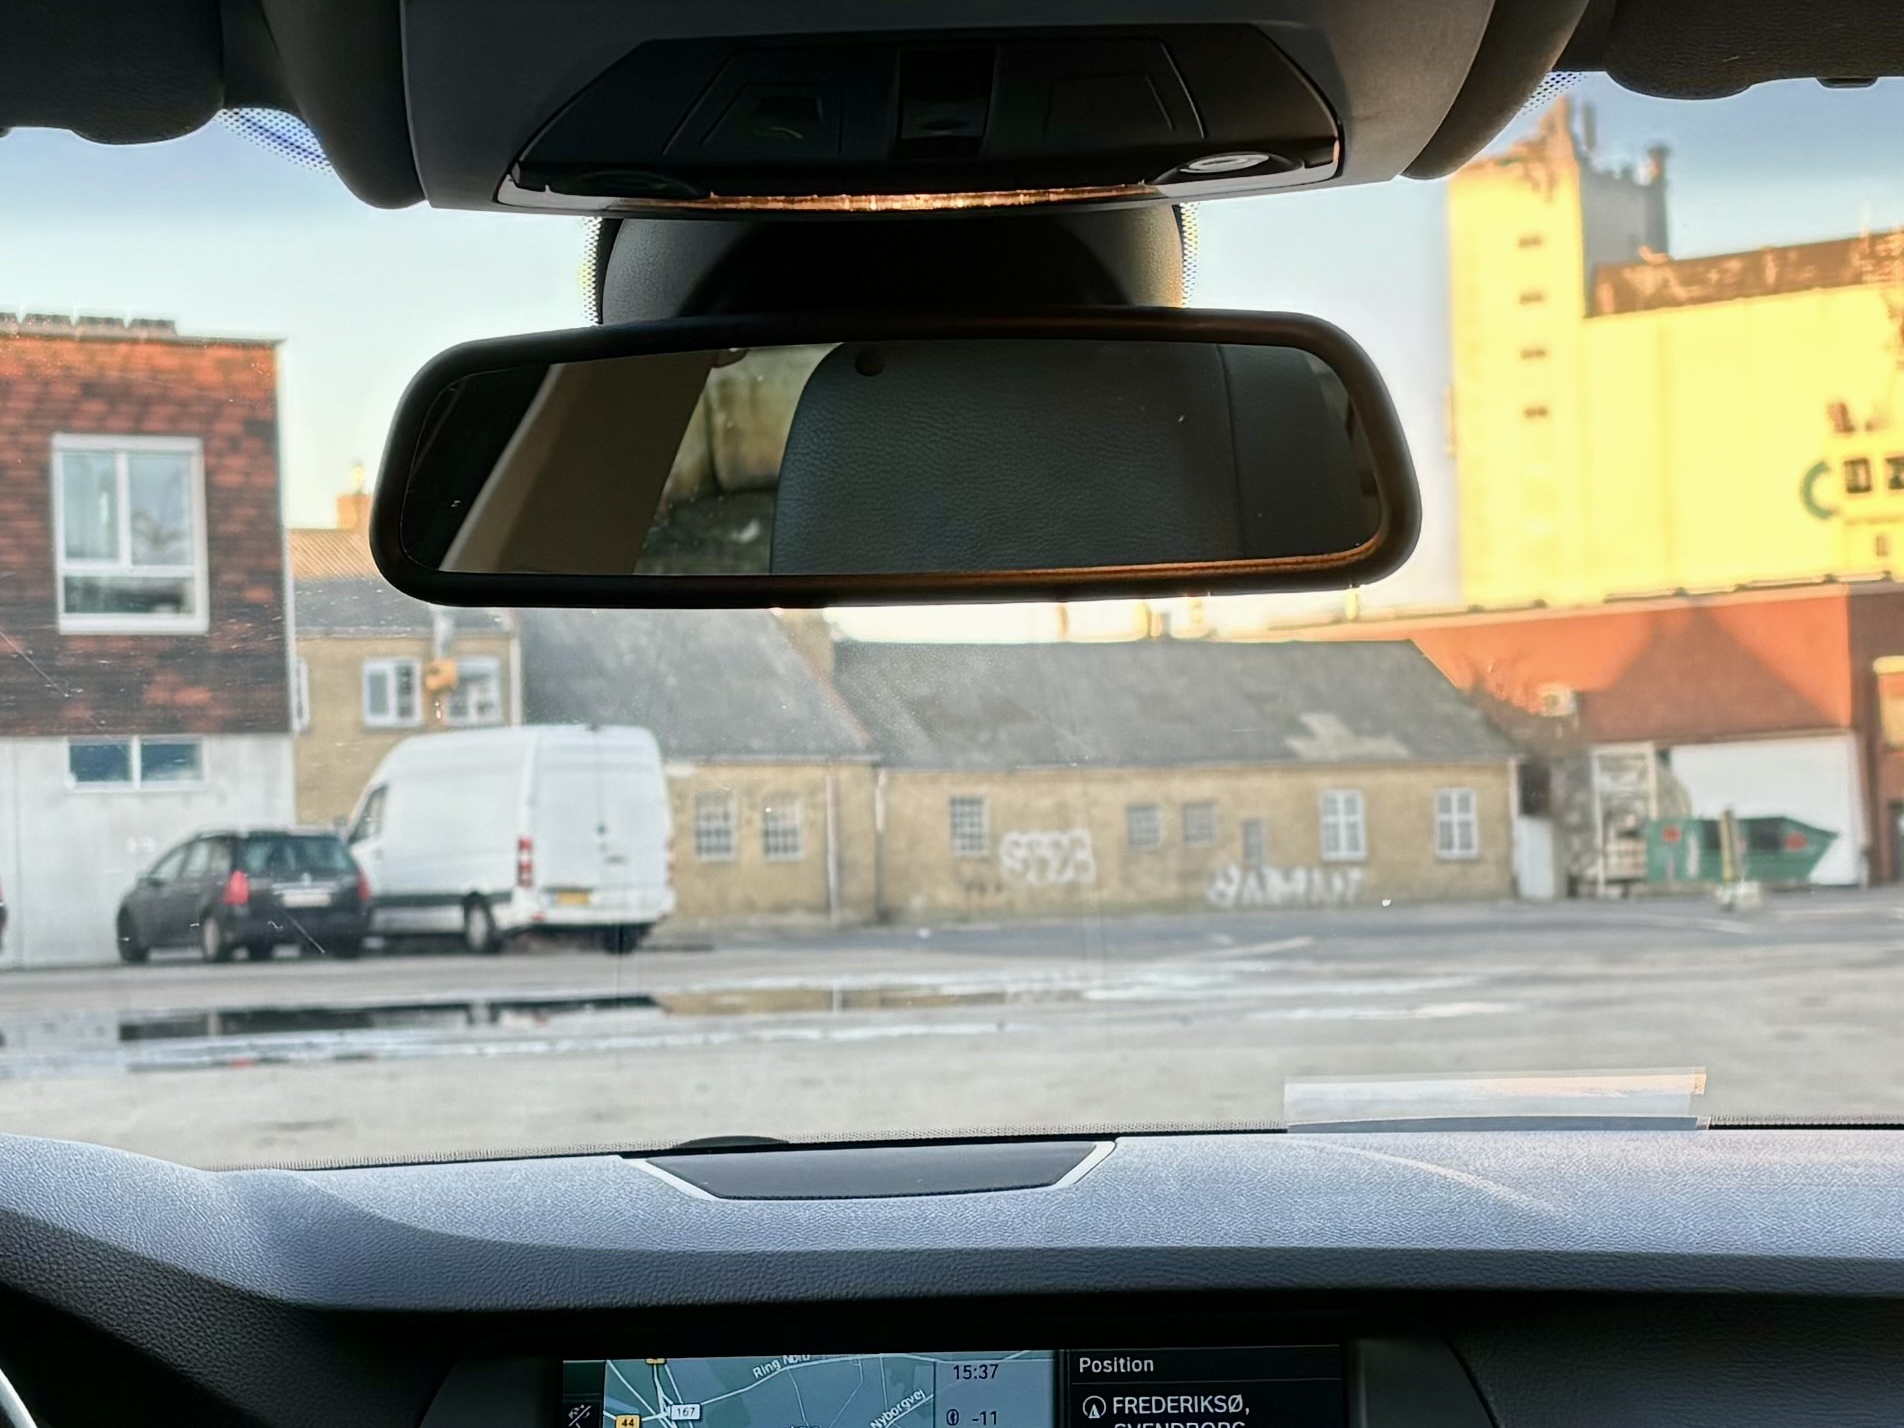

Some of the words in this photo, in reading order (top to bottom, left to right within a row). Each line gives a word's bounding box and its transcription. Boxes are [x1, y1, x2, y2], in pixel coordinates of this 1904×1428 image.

[752, 1359, 782, 1379] Ring
[953, 1363, 999, 1380] 15:37
[1079, 1356, 1154, 1373] Position
[676, 1406, 696, 1417] 167
[1112, 1394, 1250, 1416] FREDERIKSØ,
[621, 1418, 635, 1428] 44
[971, 1410, 998, 1426] -11
